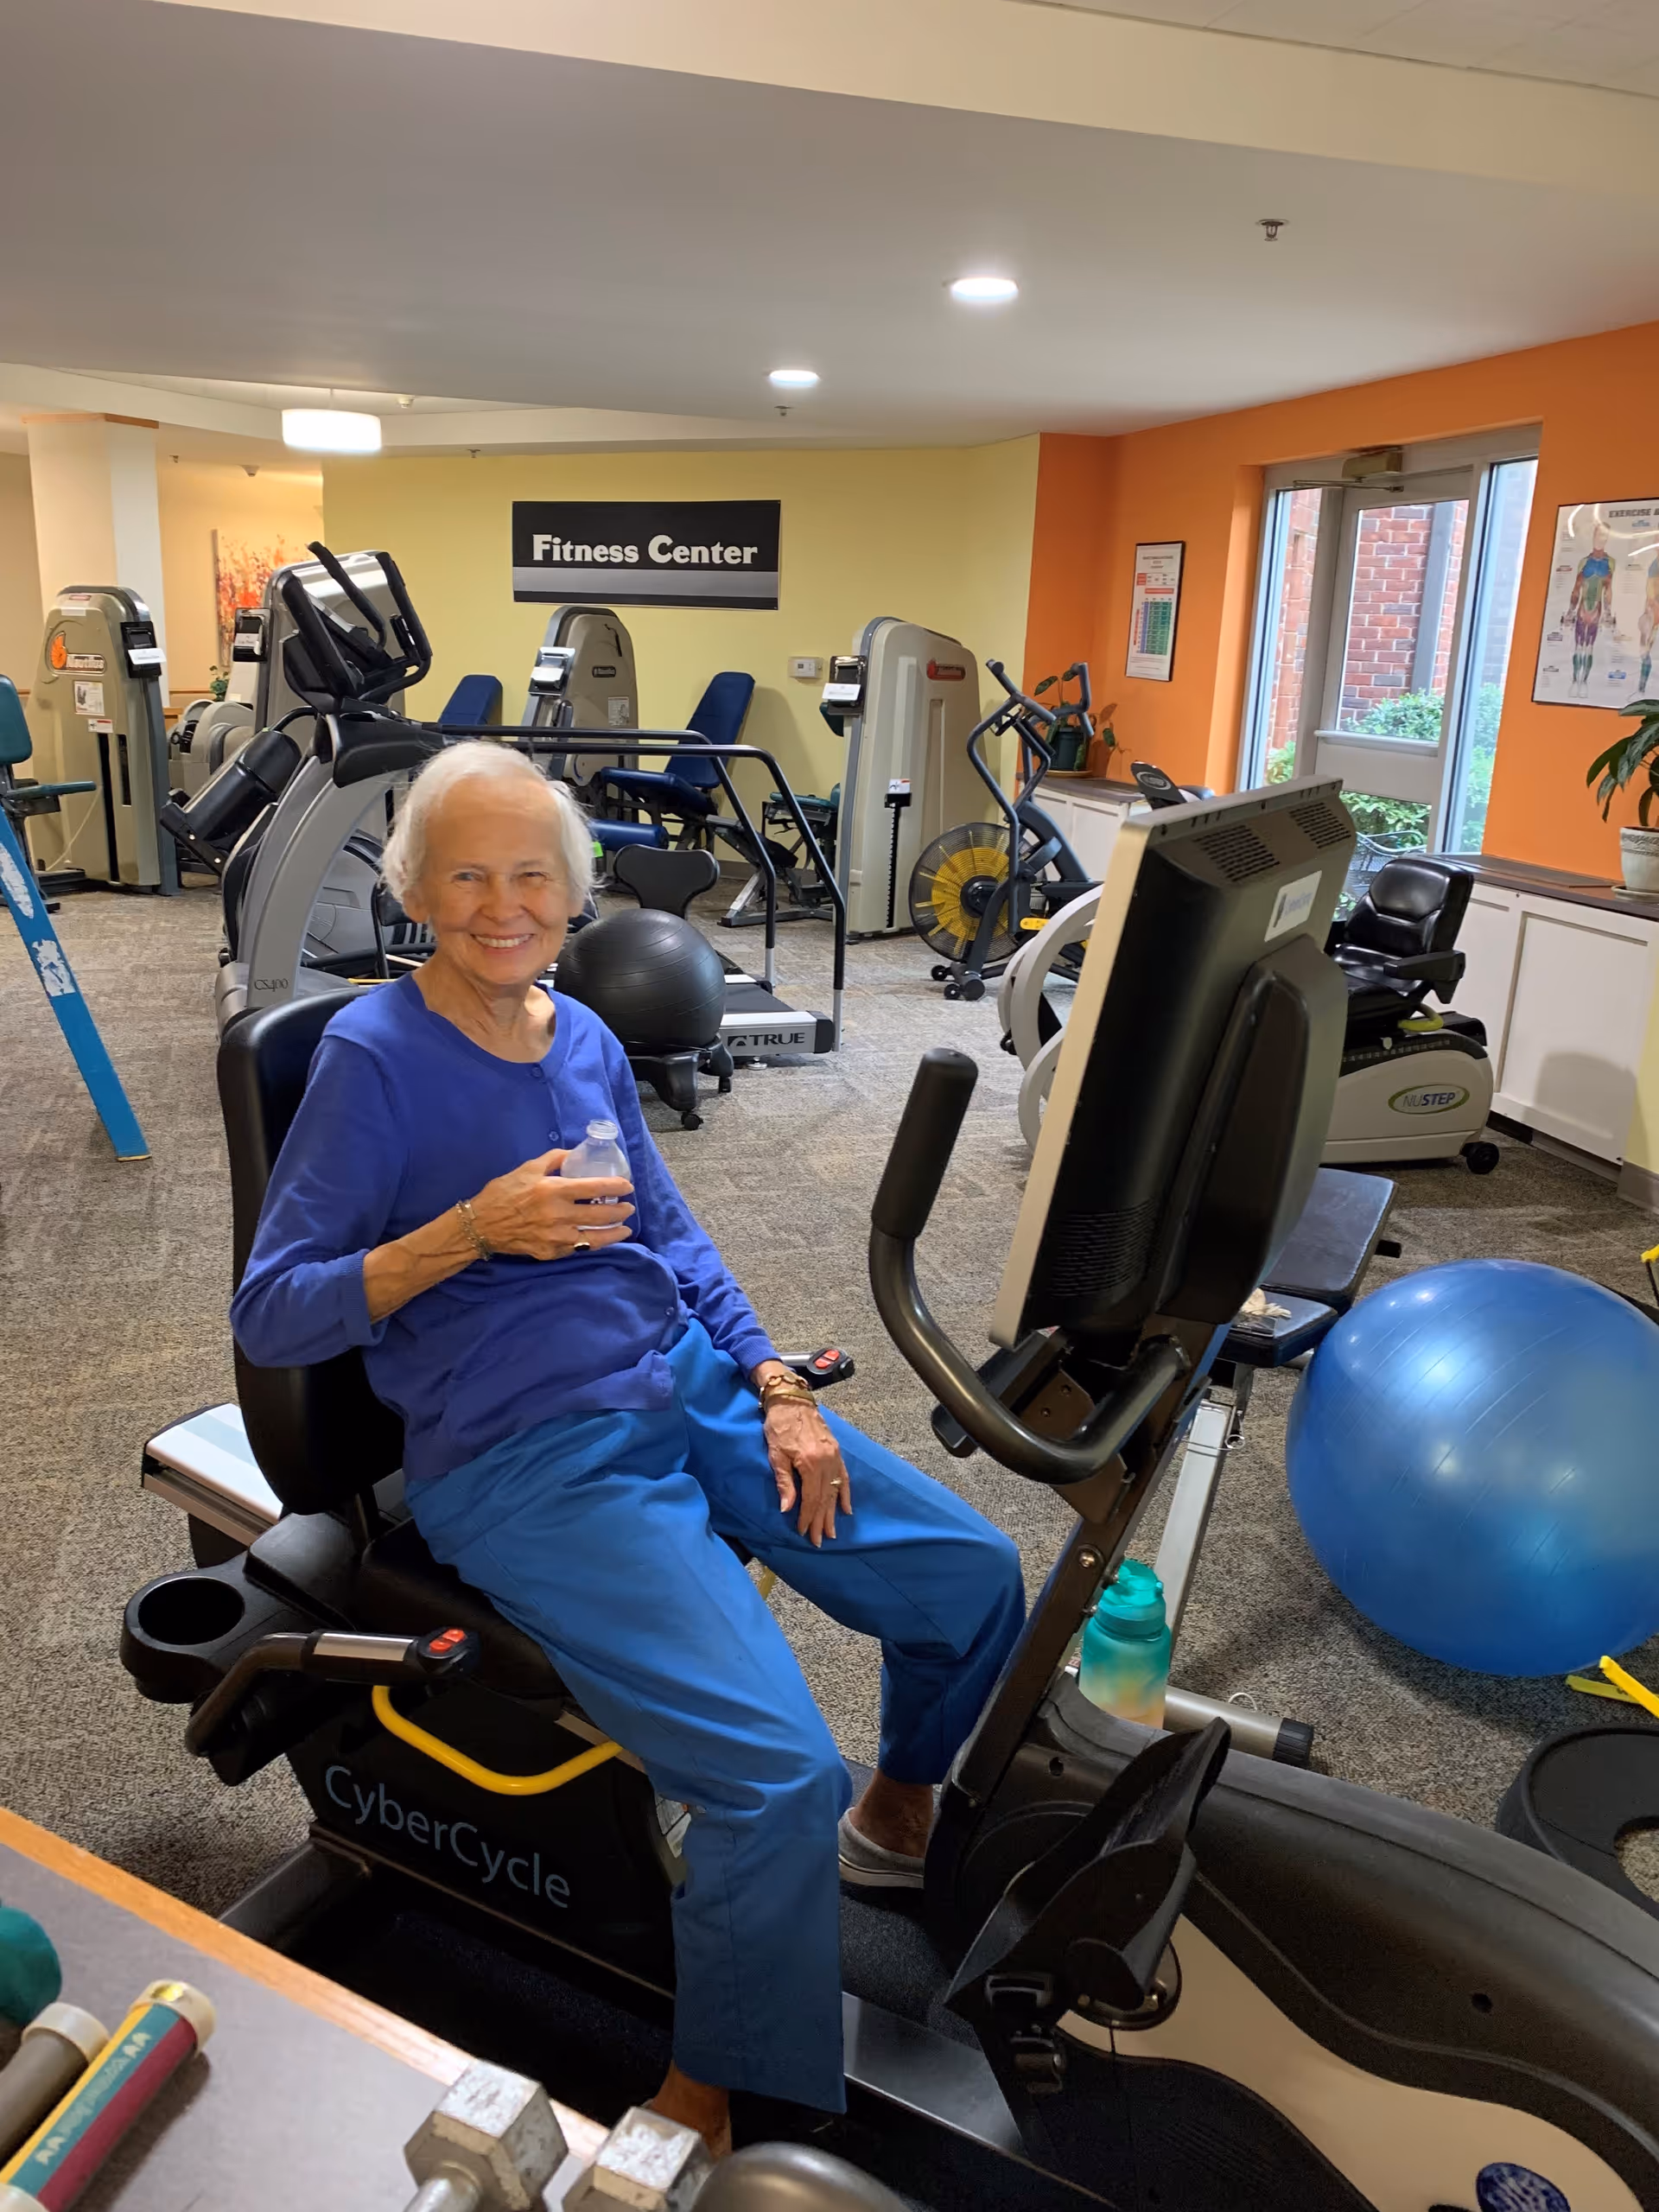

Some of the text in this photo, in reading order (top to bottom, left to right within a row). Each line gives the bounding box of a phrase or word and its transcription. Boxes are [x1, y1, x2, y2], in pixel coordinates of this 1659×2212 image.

[533, 534, 758, 564] Fitness Center
[749, 1033, 805, 1046] TRUE
[1403, 1092, 1455, 1106] NUSTEP
[326, 1765, 570, 1908] CyberCycle
